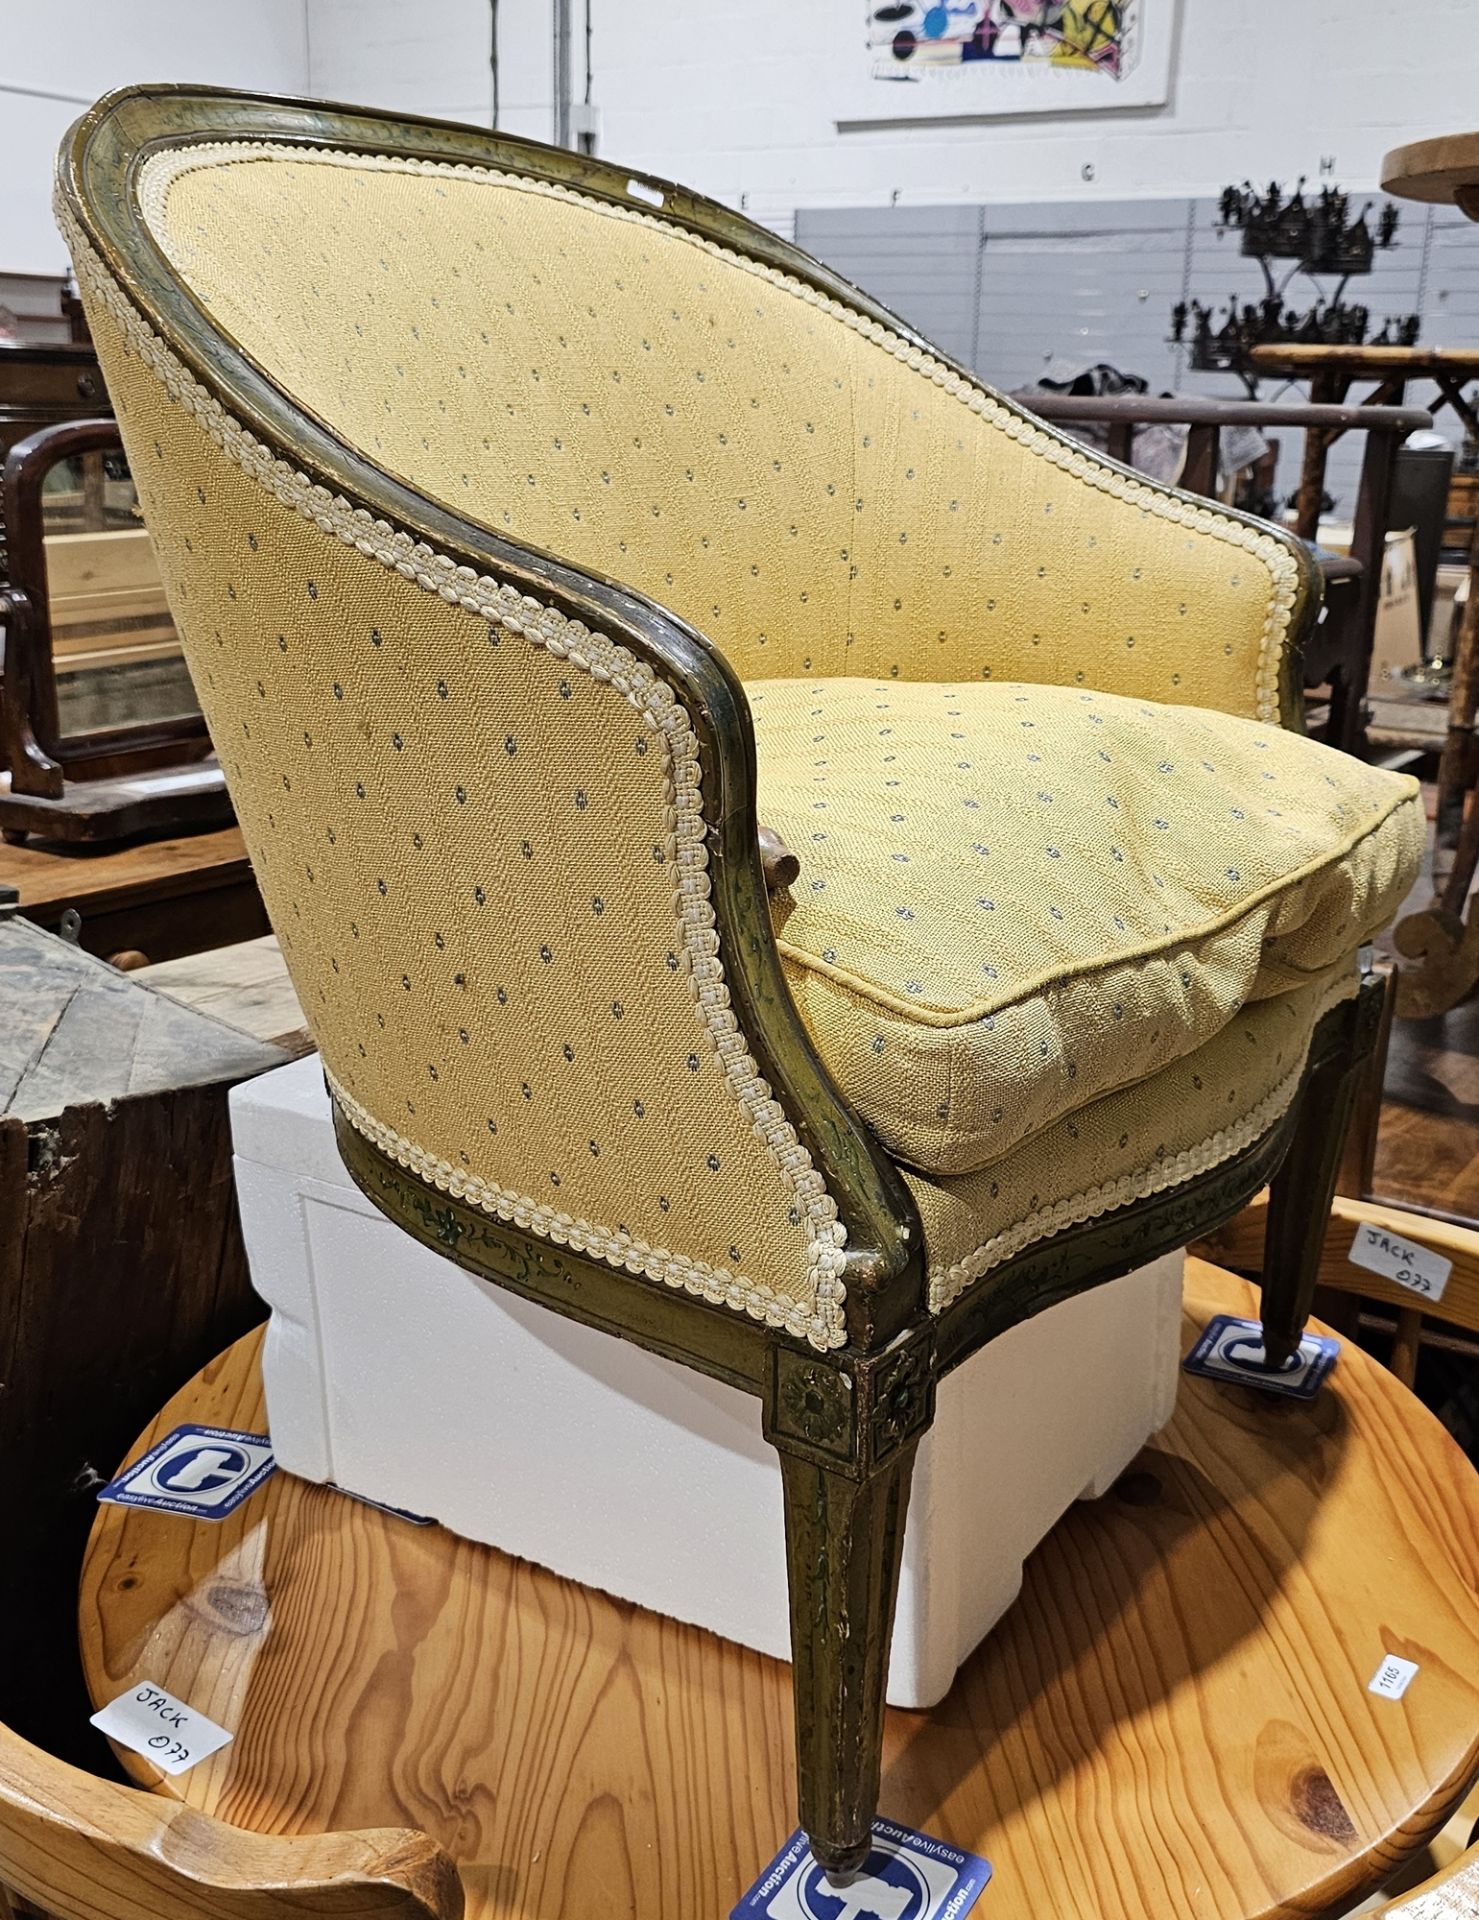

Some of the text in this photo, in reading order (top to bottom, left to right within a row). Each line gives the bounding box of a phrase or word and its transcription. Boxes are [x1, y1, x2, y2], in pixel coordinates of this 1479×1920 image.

[1366, 1229, 1415, 1266] JACK
[1379, 1666, 1400, 1689] 1165
[136, 1688, 188, 1728] JACK
[871, 1820, 965, 1864] easyliveAucti
